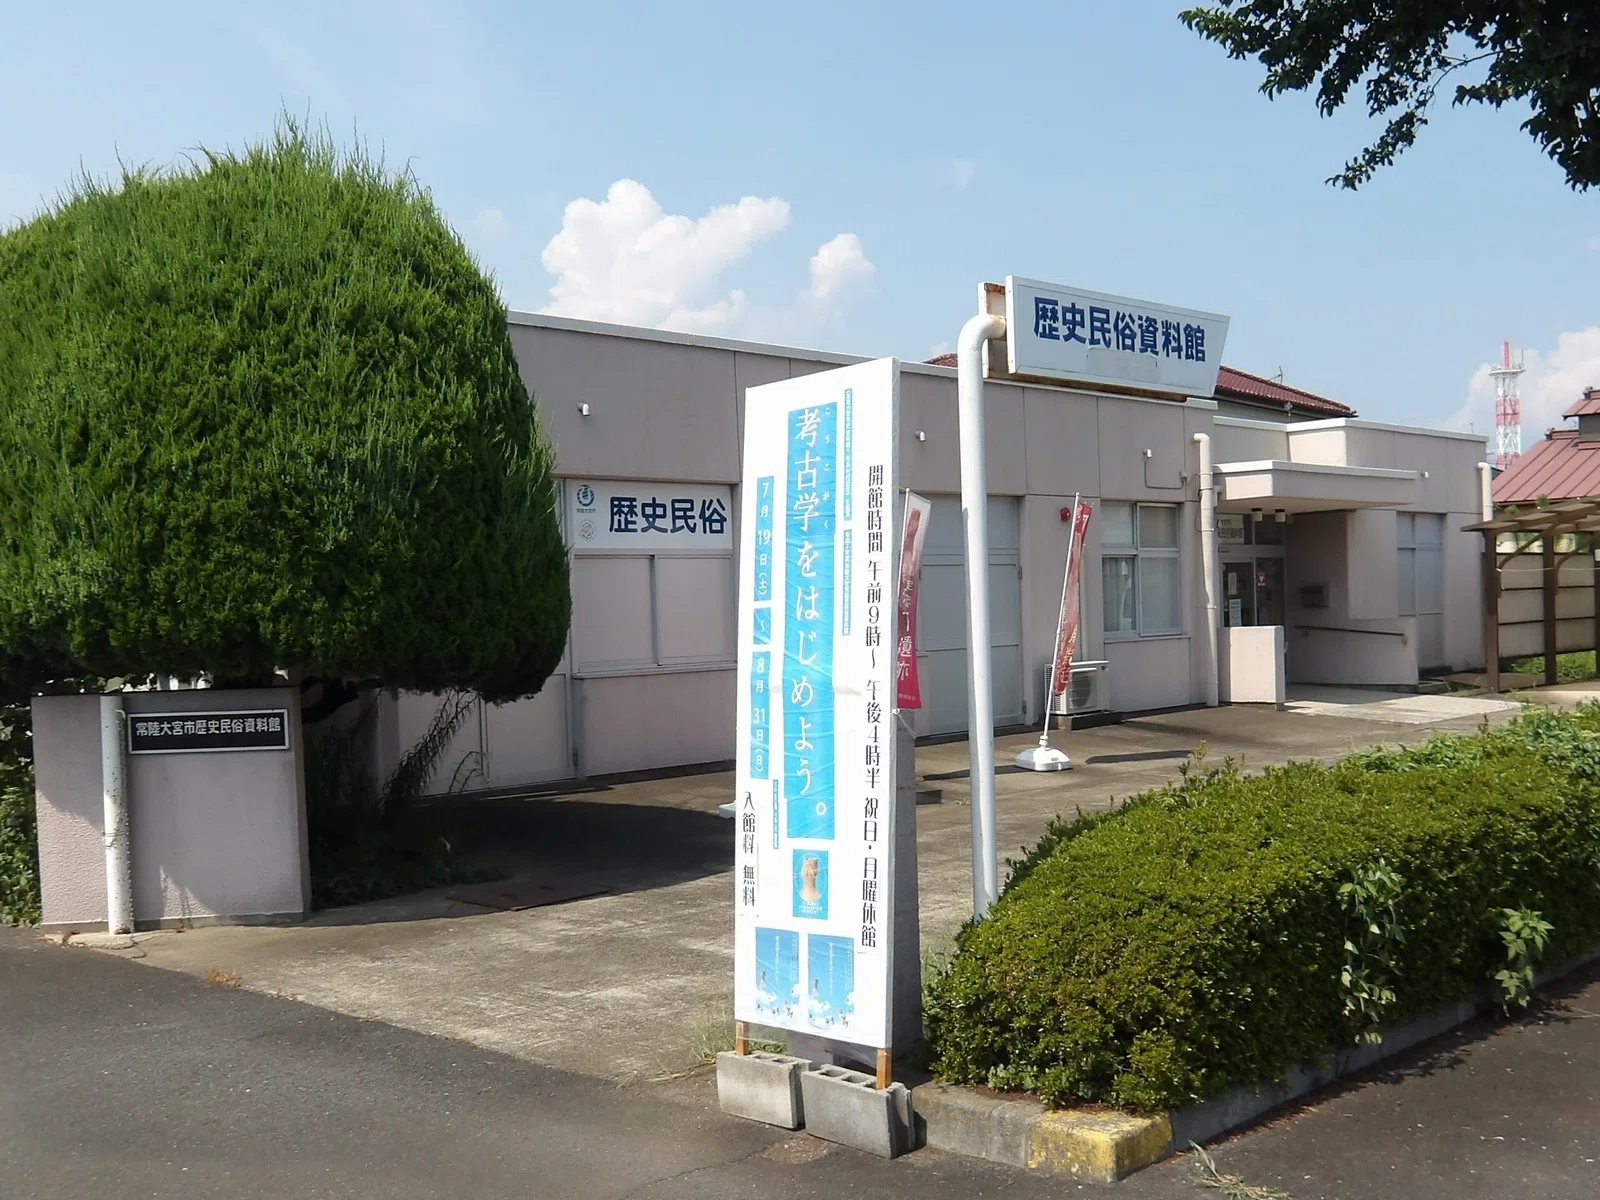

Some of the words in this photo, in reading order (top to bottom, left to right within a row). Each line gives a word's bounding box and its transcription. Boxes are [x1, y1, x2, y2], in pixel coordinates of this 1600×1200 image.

[1034, 296, 1206, 362] 歴史民俗資料館
[823, 406, 831, 529] こうこがく
[609, 496, 727, 535] 歴史民俗
[868, 464, 884, 553] 開館時間
[791, 407, 827, 816] 考古学をはじめよう。
[135, 717, 281, 737] 常陸大宮市歴史民俗資料館
[865, 680, 881, 789] 午後4時半
[743, 791, 756, 854] 入館料
[743, 864, 756, 907] 無料
[861, 797, 879, 948] 祝日・月曜休館
